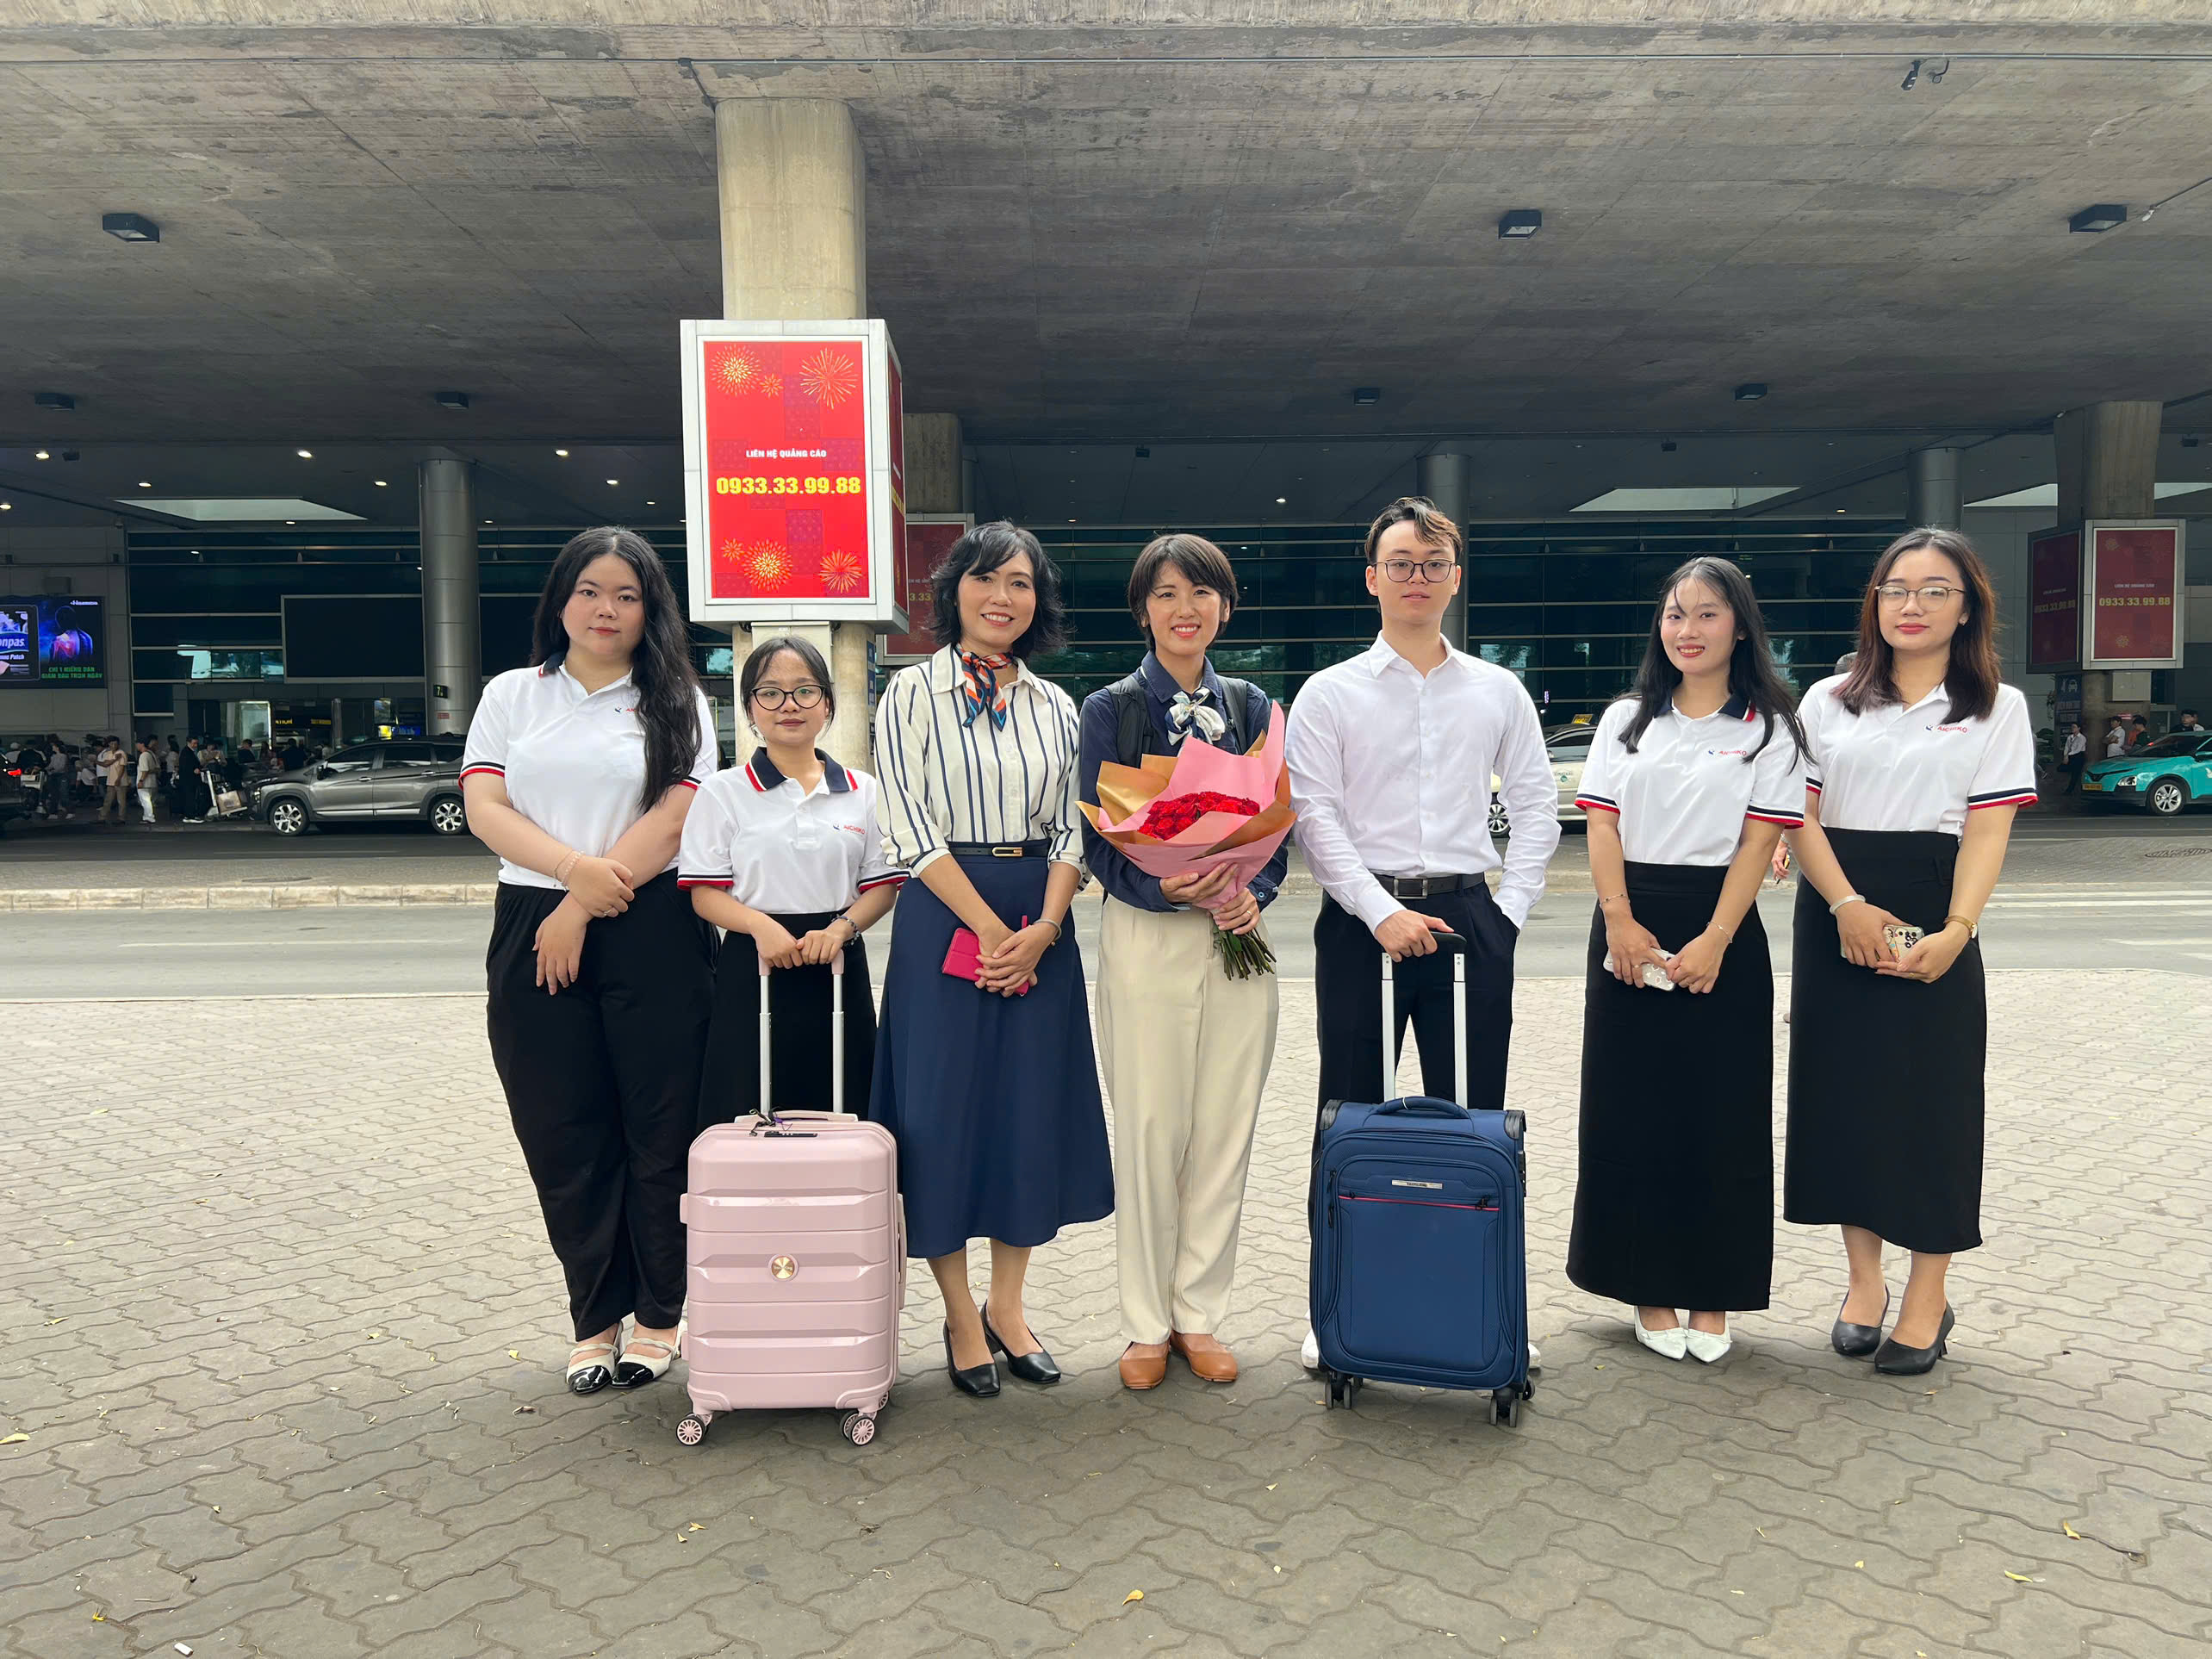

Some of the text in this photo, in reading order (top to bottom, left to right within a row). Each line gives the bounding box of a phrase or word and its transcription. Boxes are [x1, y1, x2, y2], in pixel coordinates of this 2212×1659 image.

[746, 448, 827, 459] LIÊN HỆ QUẢNG CÁO
[716, 476, 861, 494] 0933.33.99.88
[2098, 597, 2171, 606] 0933.33.99.88
